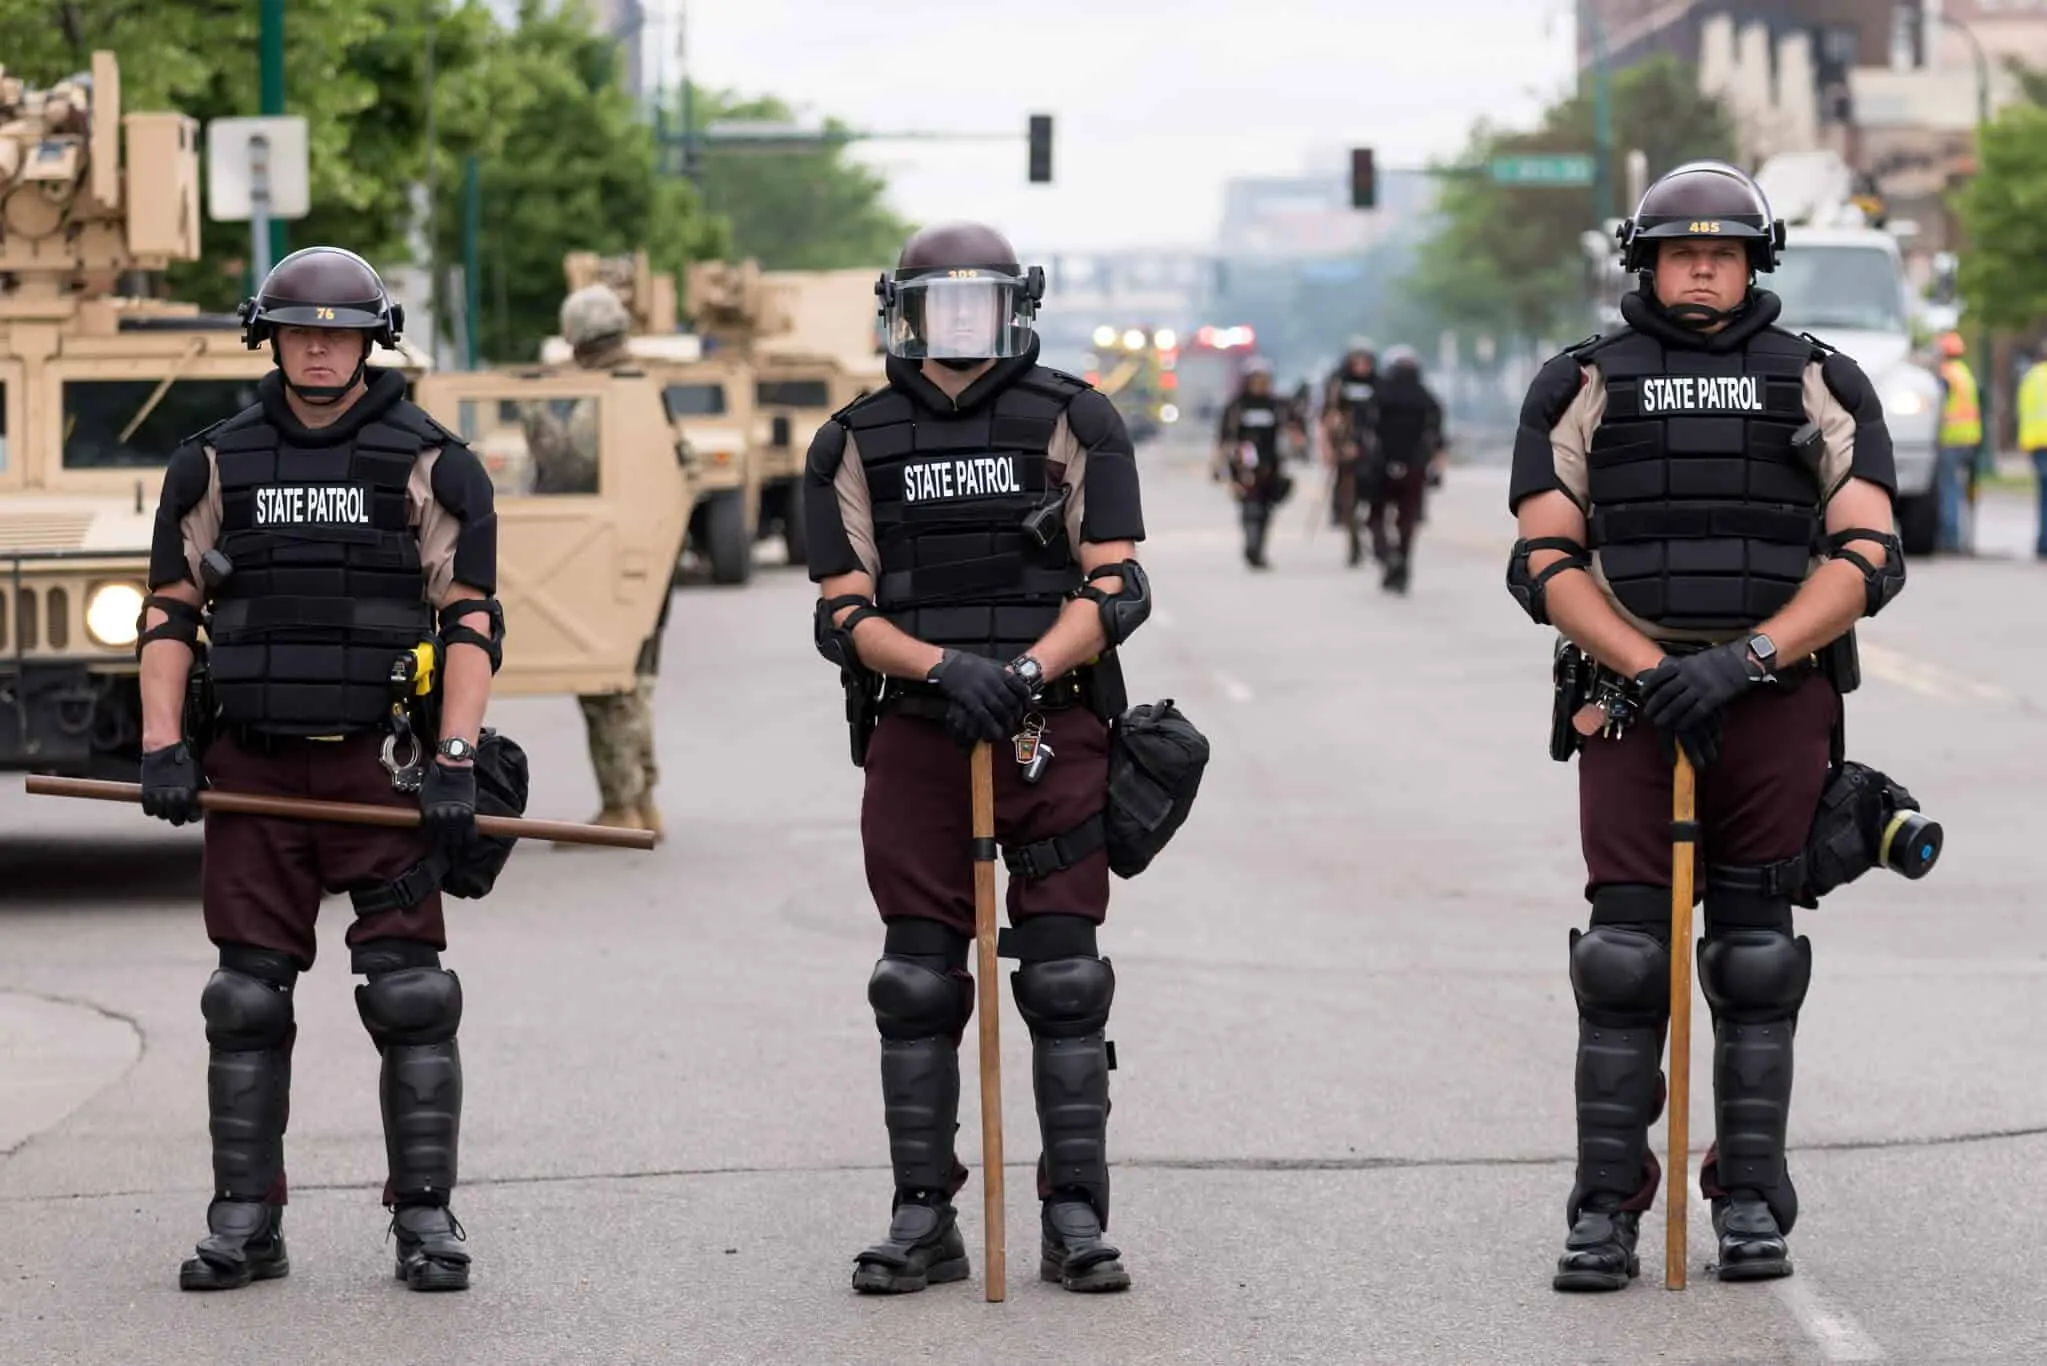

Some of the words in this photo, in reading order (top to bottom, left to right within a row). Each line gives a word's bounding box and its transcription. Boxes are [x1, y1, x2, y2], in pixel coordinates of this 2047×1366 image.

[316, 307, 335, 320] 76
[1644, 378, 1695, 411] STATE
[1697, 376, 1762, 410] PATROL
[904, 462, 954, 502] STATE
[955, 456, 1020, 496] PATROL
[256, 488, 304, 524] STATE
[307, 487, 369, 523] PATROL
